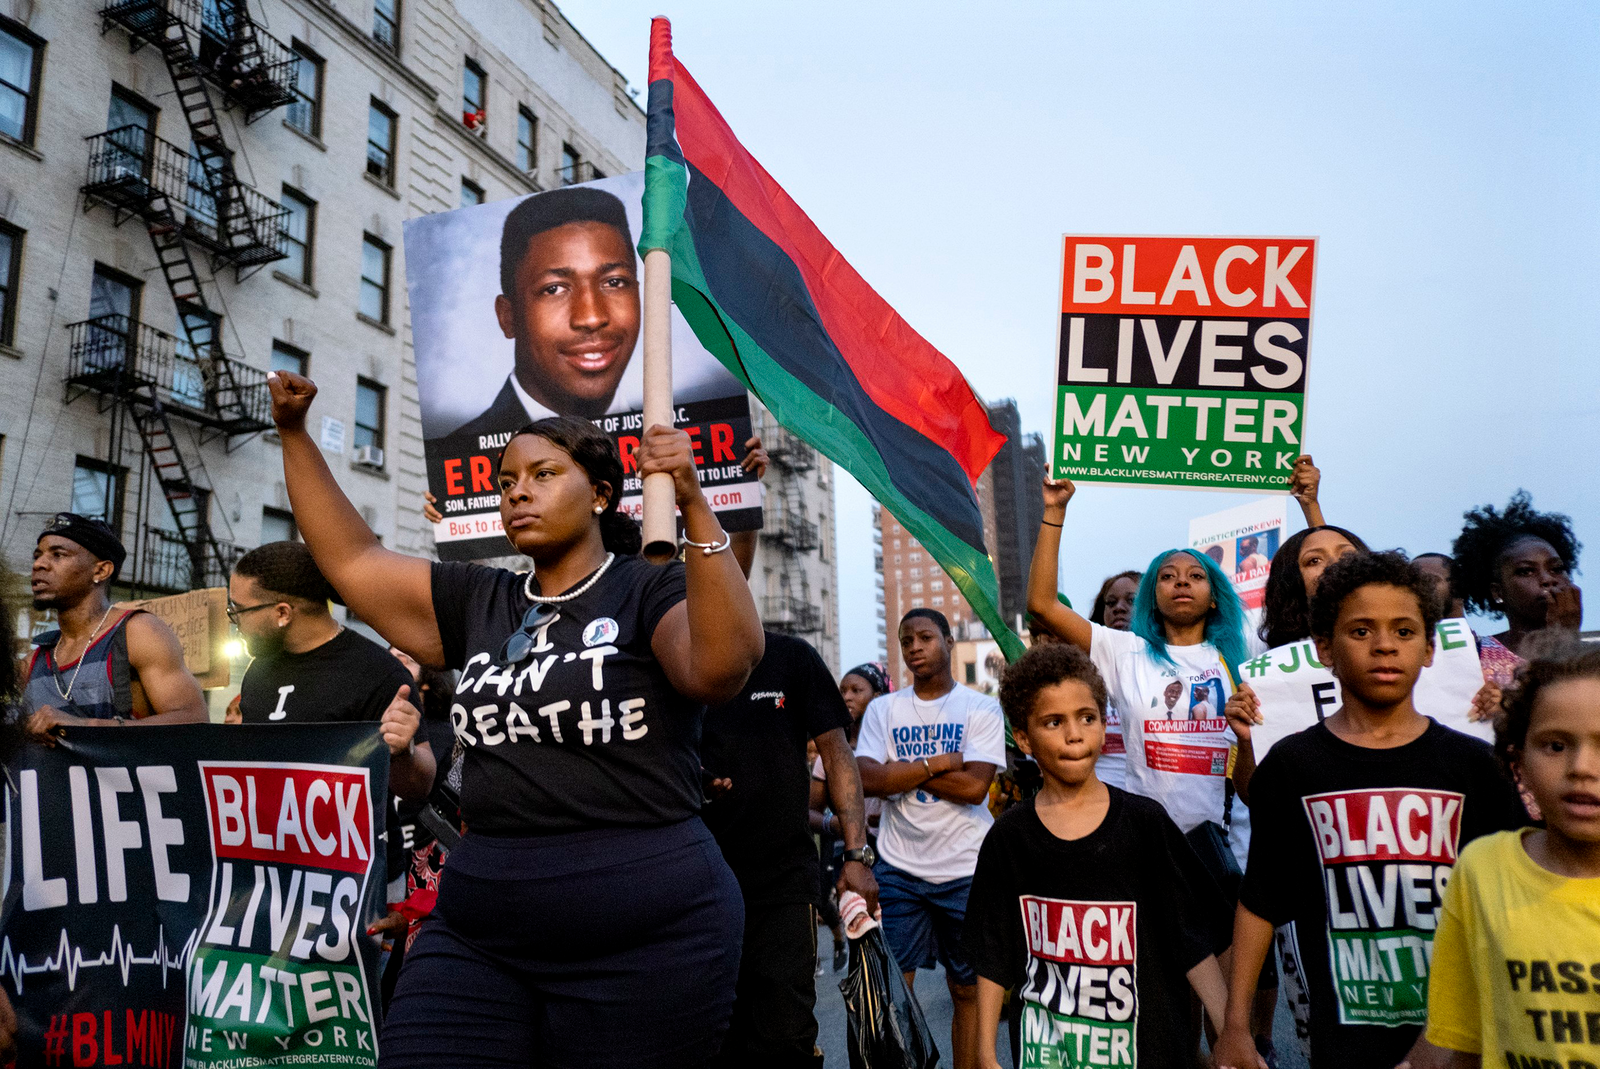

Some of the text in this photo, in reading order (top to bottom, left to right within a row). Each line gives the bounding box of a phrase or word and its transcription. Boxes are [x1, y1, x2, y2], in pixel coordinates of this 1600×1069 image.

[1073, 243, 1309, 309] BLACK
[1067, 317, 1303, 389] LIVES
[479, 432, 512, 450] RALLY
[604, 417, 619, 433] OF
[1063, 392, 1299, 445] MATTER
[444, 453, 501, 496] ER
[1062, 442, 1295, 470] NEW YORK
[445, 498, 467, 512] SON,
[467, 494, 502, 510] FATHER
[707, 468, 721, 480] TO
[722, 466, 743, 479] LIFE
[449, 522, 472, 536] Bus
[475, 520, 488, 533] to
[1193, 518, 1282, 547] #JUSTICEFORKEVIN
[531, 613, 561, 653] I
[455, 644, 619, 696] CAN'T
[268, 684, 295, 720] I
[450, 697, 649, 747] REATHE
[1148, 720, 1227, 732] COMMUNITY RALLY
[892, 724, 964, 744] FORTUNE
[896, 740, 961, 757] FAVORS THE
[20, 766, 190, 911] LIFE
[212, 774, 368, 860] BLACK
[1310, 794, 1460, 859] BLACK
[205, 862, 358, 962] LIVES
[1027, 900, 1133, 961] BLACK
[1336, 936, 1433, 983] MATT
[190, 958, 369, 1027] MATTER
[1023, 957, 1134, 1021] LIVES
[43, 1009, 175, 1067] #BLMNY
[188, 1025, 372, 1053] NEW YORK
